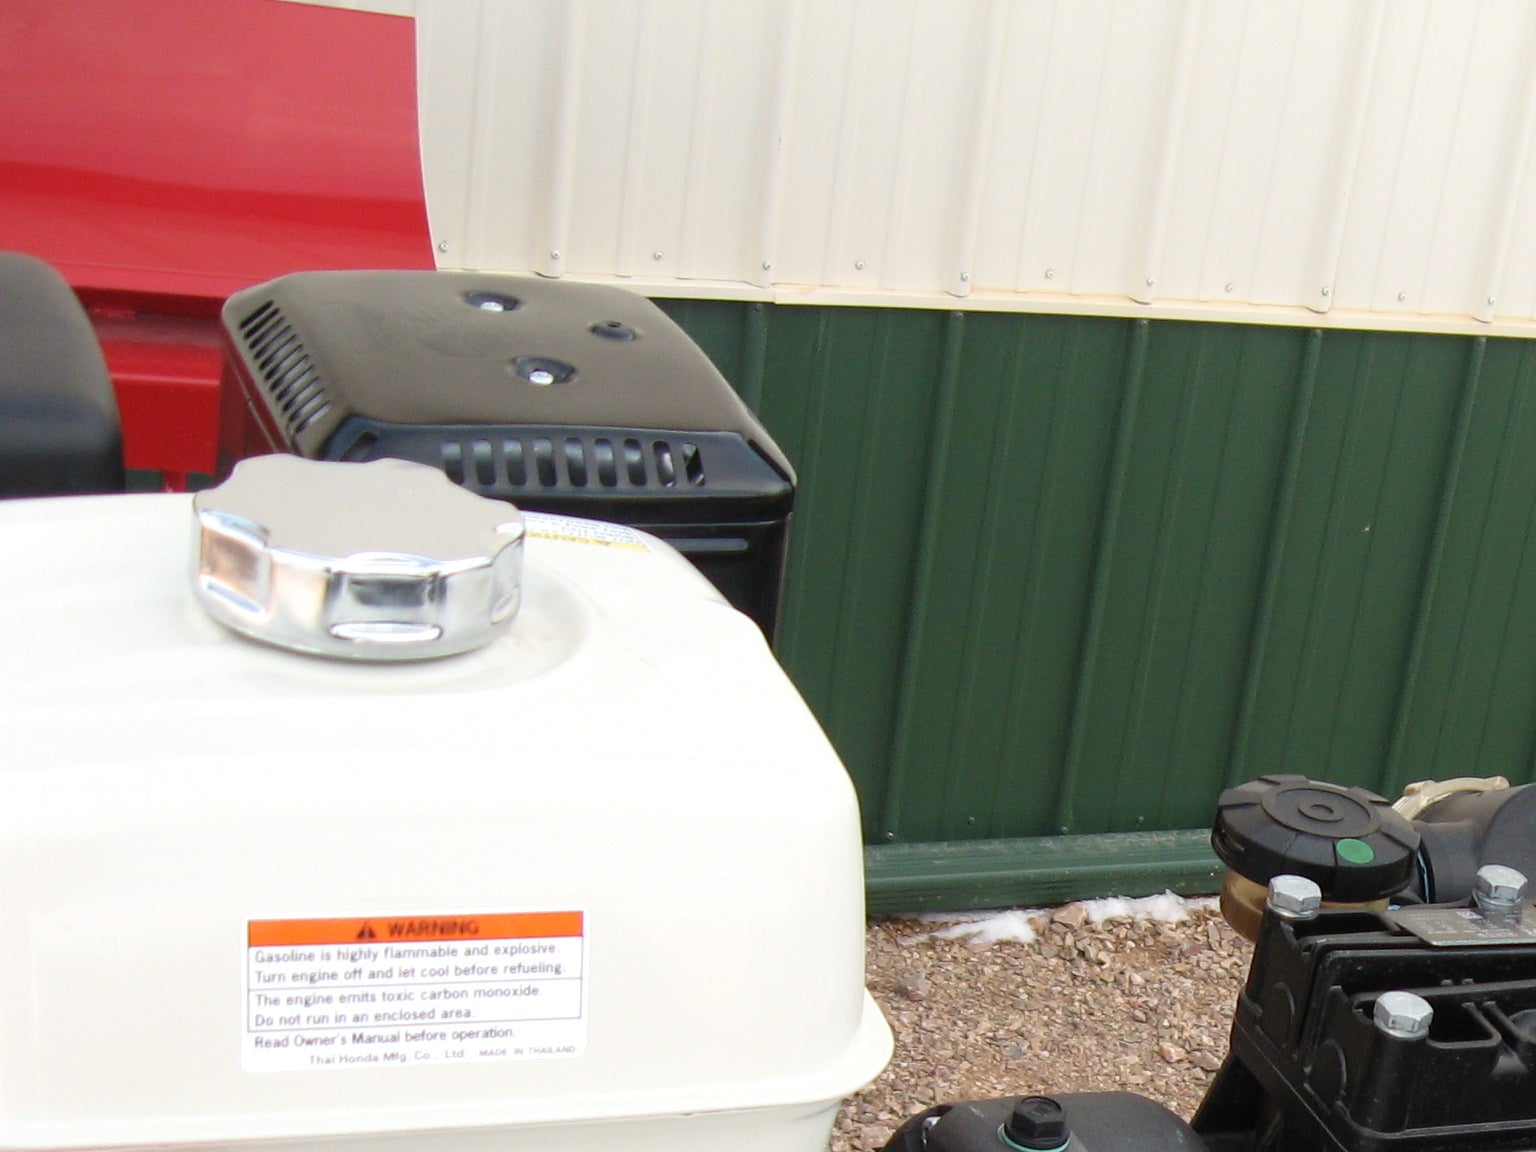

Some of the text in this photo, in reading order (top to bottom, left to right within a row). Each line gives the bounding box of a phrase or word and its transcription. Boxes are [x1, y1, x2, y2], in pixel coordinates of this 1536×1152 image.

[388, 919, 480, 936] WARNING
[255, 949, 316, 963] Gasoline
[320, 949, 332, 961] is
[337, 947, 379, 962] highly
[384, 945, 458, 959] flammable
[464, 944, 489, 956] and
[256, 961, 565, 984] Turn engine off and let cool before refueling.
[256, 993, 281, 1007] The
[286, 992, 333, 1007] engine
[339, 990, 377, 1003] emits
[382, 989, 415, 1002] toxic
[421, 988, 469, 1000] carbon
[255, 1014, 274, 1027] Do
[279, 1013, 301, 1026] not
[306, 1013, 329, 1024] run
[334, 1012, 347, 1024] in
[352, 1012, 369, 1023] an
[374, 1009, 436, 1022] enclosed
[255, 1035, 289, 1048] Read
[294, 1033, 347, 1047] Owner's
[352, 1031, 401, 1044] Manual
[405, 1028, 447, 1041] before
[309, 1053, 335, 1065] Thai
[339, 1052, 379, 1064] Honda
